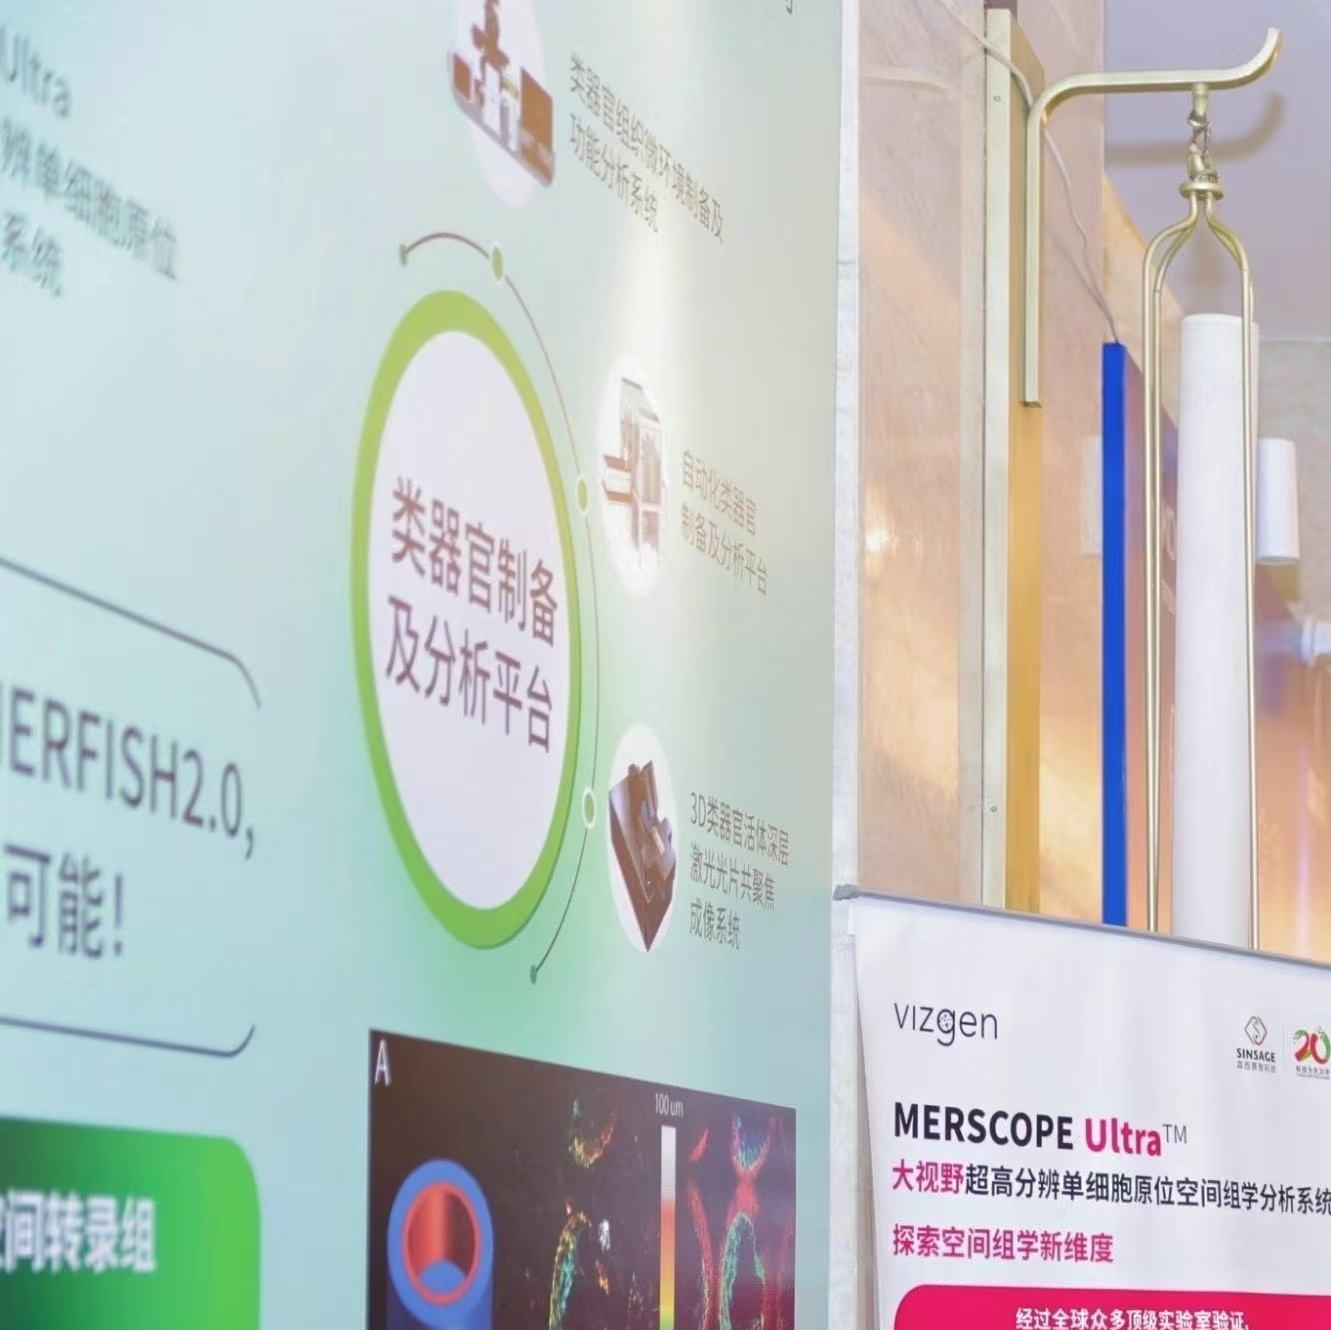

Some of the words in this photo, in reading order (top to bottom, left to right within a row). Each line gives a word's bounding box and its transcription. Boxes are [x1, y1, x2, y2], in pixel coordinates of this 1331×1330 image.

[569, 112, 658, 233] 功能分析系统
[682, 448, 757, 537] 自动化类器官
[391, 475, 558, 648] 类器官制备
[681, 503, 768, 595] 制备及分析平台
[386, 594, 553, 753] 及分析平台
[0, 680, 255, 861] ERFISH2.0,
[690, 791, 790, 867] 3D类器官活体深层
[689, 898, 743, 951] 成像系统
[374, 1039, 391, 1087] A
[1236, 1047, 1276, 1064] SINSAGE
[893, 1101, 1074, 1150] MERSCOPE
[0, 1188, 157, 1274] 间转录组
[892, 1223, 1114, 1264] 探索空间组学新维度
